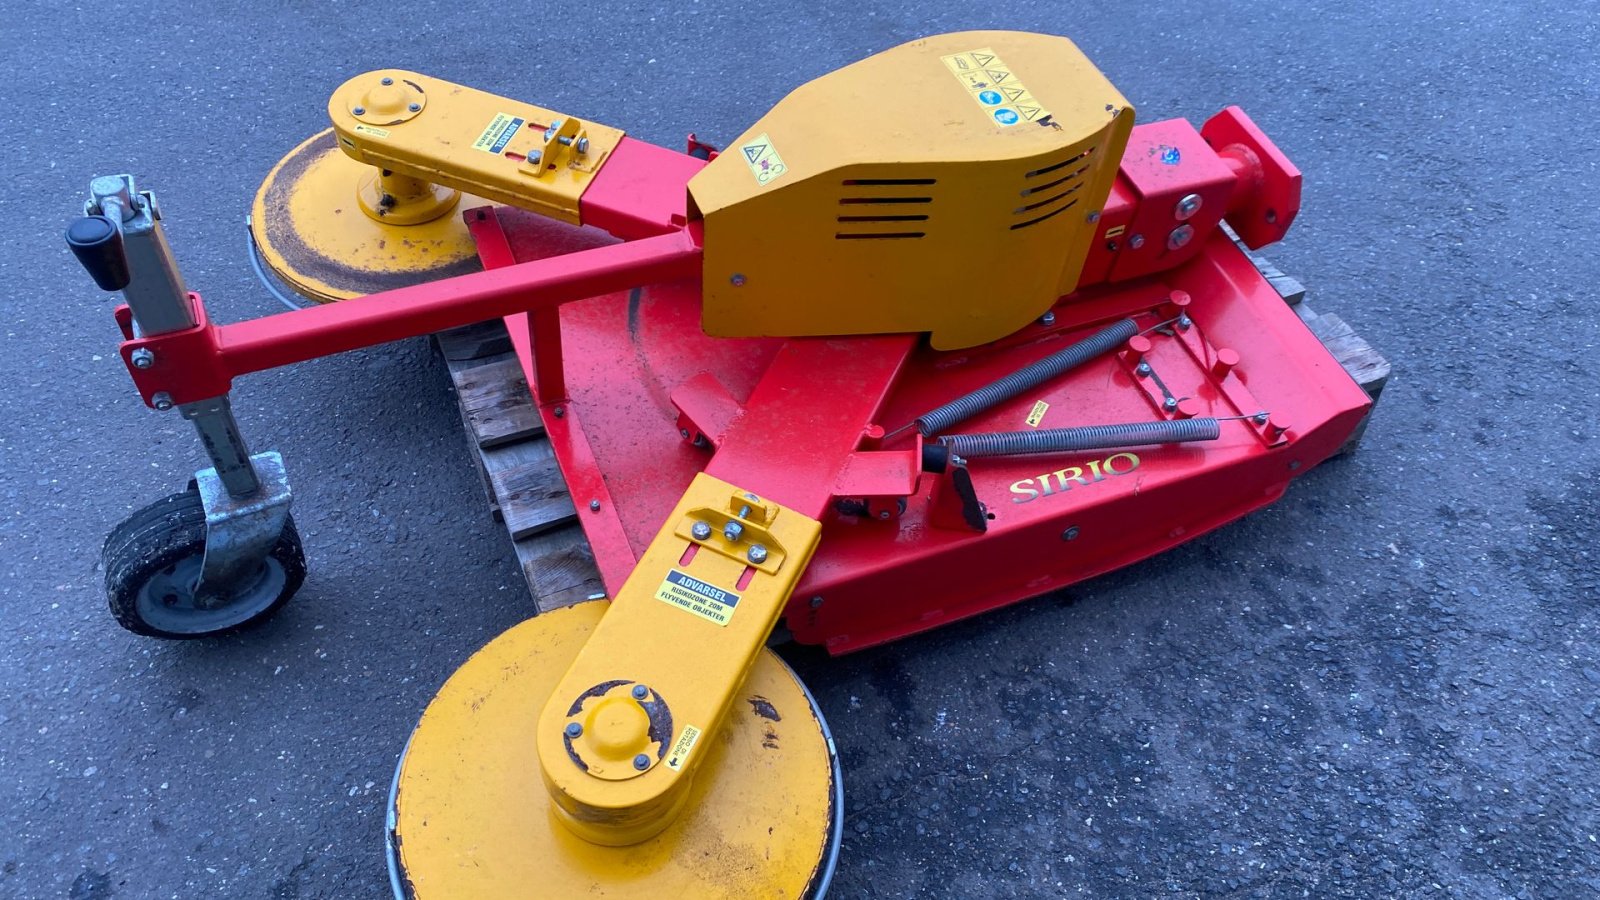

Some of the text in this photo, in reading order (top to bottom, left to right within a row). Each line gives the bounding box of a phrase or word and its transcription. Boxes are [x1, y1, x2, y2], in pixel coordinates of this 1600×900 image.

[1009, 452, 1140, 504] SIRIO
[671, 586, 723, 612] RISIKOZONE 20M
[677, 576, 726, 602] ADVARSEL
[660, 591, 725, 622] FLYVENDE OBJEKTER
